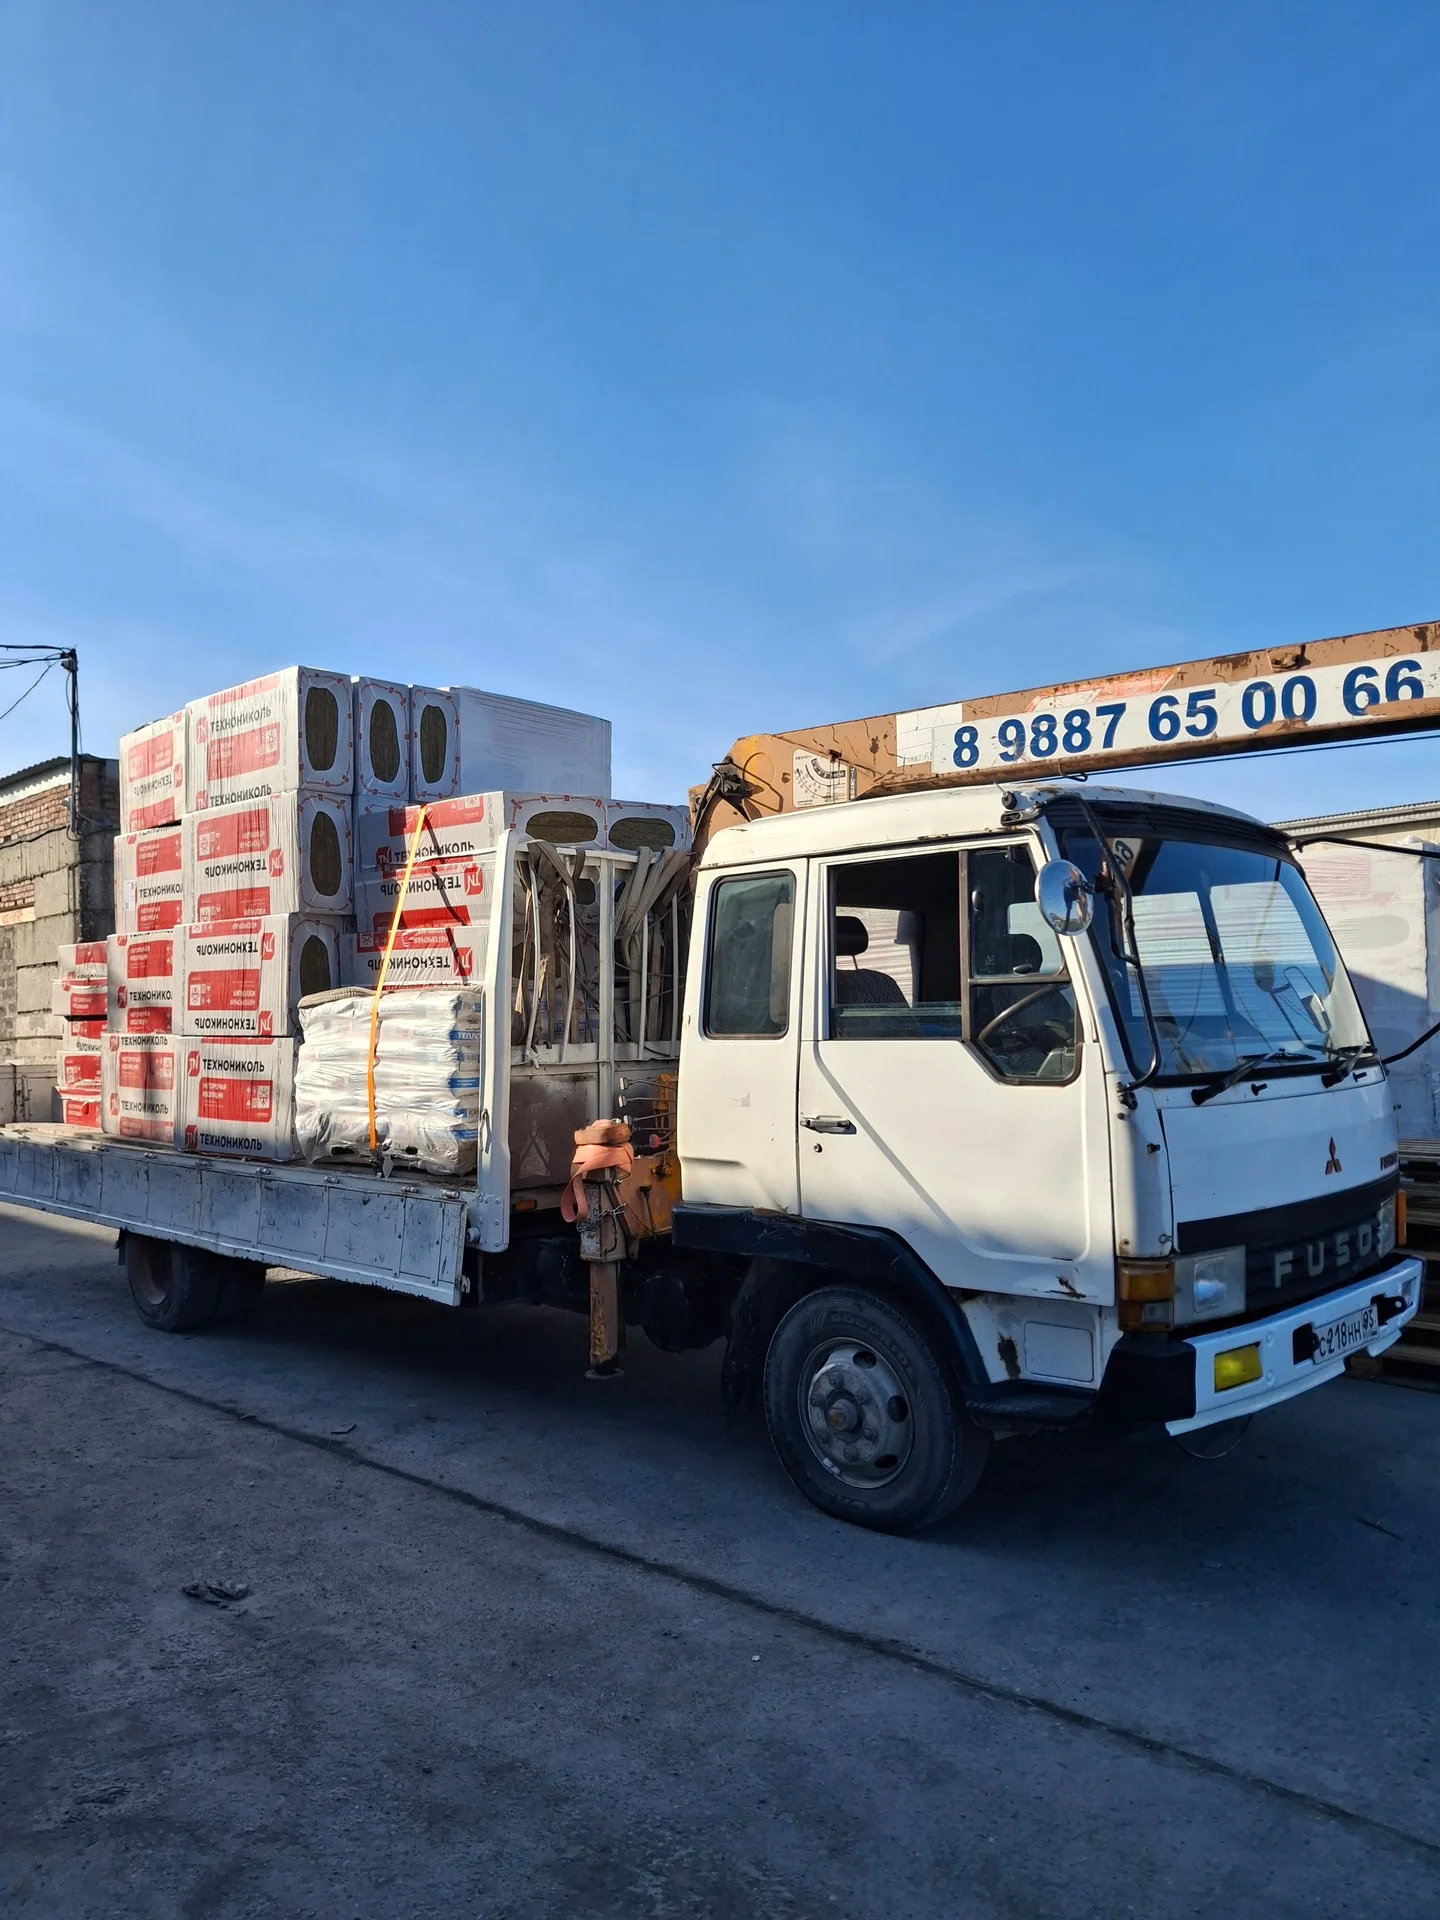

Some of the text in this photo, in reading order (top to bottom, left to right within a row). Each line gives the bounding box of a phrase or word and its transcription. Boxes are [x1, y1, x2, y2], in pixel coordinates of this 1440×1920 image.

[210, 706, 272, 733] ТЕХНОНИКОЛЬ
[953, 659, 1424, 768] 8 9887 65 00 66
[210, 784, 272, 806] ТЕХНОНИКОЛЬ
[394, 841, 475, 863] ТЕНОНИКОЛЬ
[204, 859, 267, 878] ТЕХНОНИКОЛЬ
[380, 876, 461, 896] ТЕХНОНИОЛЬ
[196, 941, 258, 956] ТЕХНОНИКОЛЬ
[368, 956, 450, 971] ТЕХНОНИКЛЬ
[129, 990, 172, 1002] ТЕХНОНИКО
[195, 1017, 256, 1031] ТЕХНОНИКОЛЬ
[121, 1036, 168, 1046] ТЕХНОНИКОЛЬ
[203, 1059, 265, 1073] ТЕХНОНИКОЛЬ
[121, 1101, 168, 1114] ТЕХНОНИКОЛЬ
[200, 1133, 262, 1151] ТЕХНОНИКОЛЬ
[1273, 1223, 1373, 1289] FUSO
